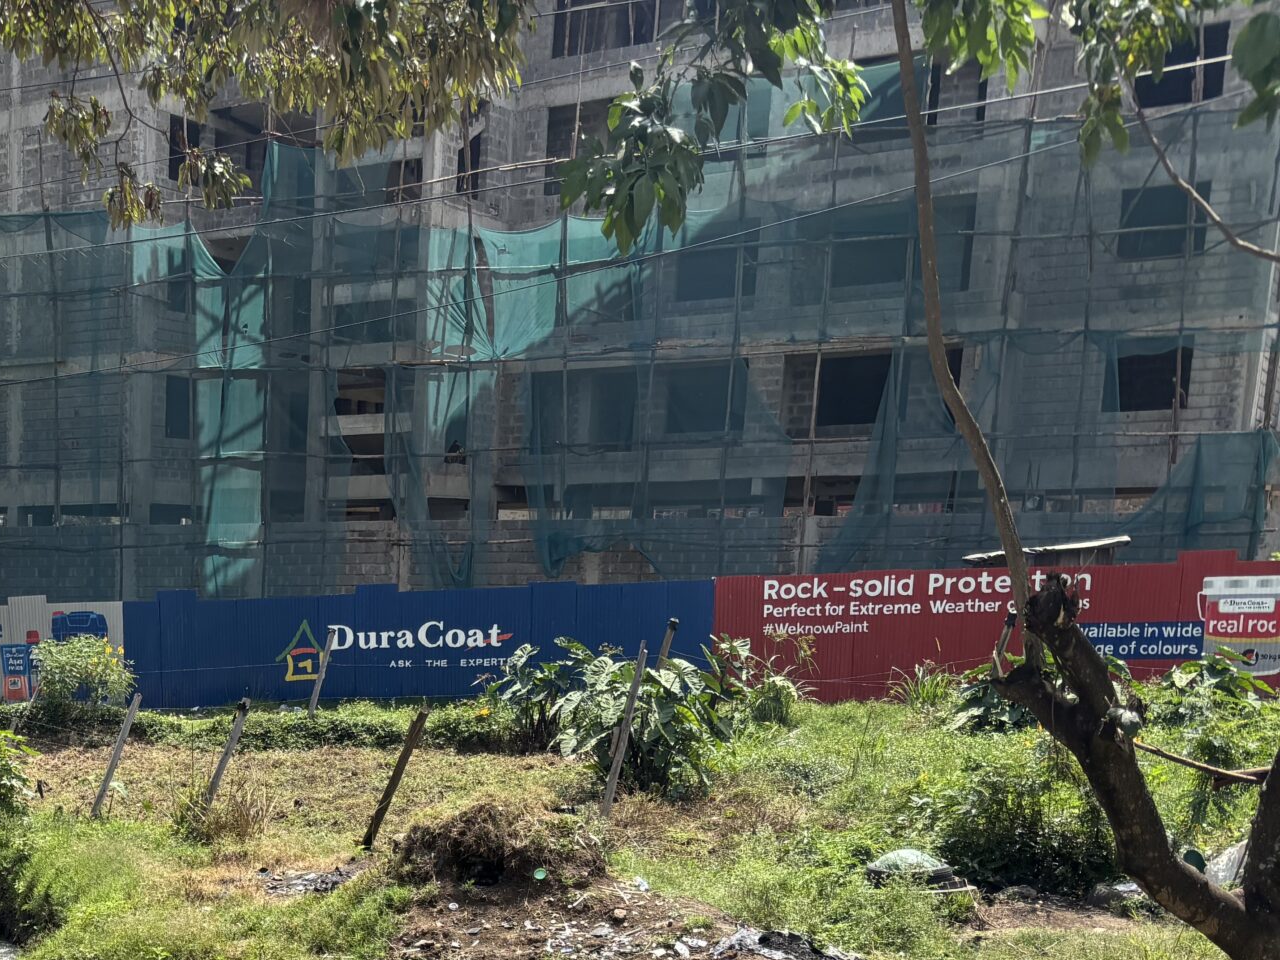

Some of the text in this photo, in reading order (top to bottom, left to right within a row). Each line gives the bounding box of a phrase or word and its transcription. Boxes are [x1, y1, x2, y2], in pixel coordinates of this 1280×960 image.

[928, 570, 1092, 595] Proteton
[763, 603, 821, 617] Perfect
[825, 602, 845, 616] for
[849, 602, 921, 616] Extreme
[929, 599, 1001, 613] Weather
[762, 621, 869, 635] #WeknowPaint
[1077, 623, 1202, 637] vailable in wide
[1209, 614, 1244, 633] real
[327, 621, 502, 650] DuraCoat
[1119, 641, 1136, 654] of
[1140, 640, 1198, 655] colours
[389, 657, 514, 668] ASK THE EXPERTS
